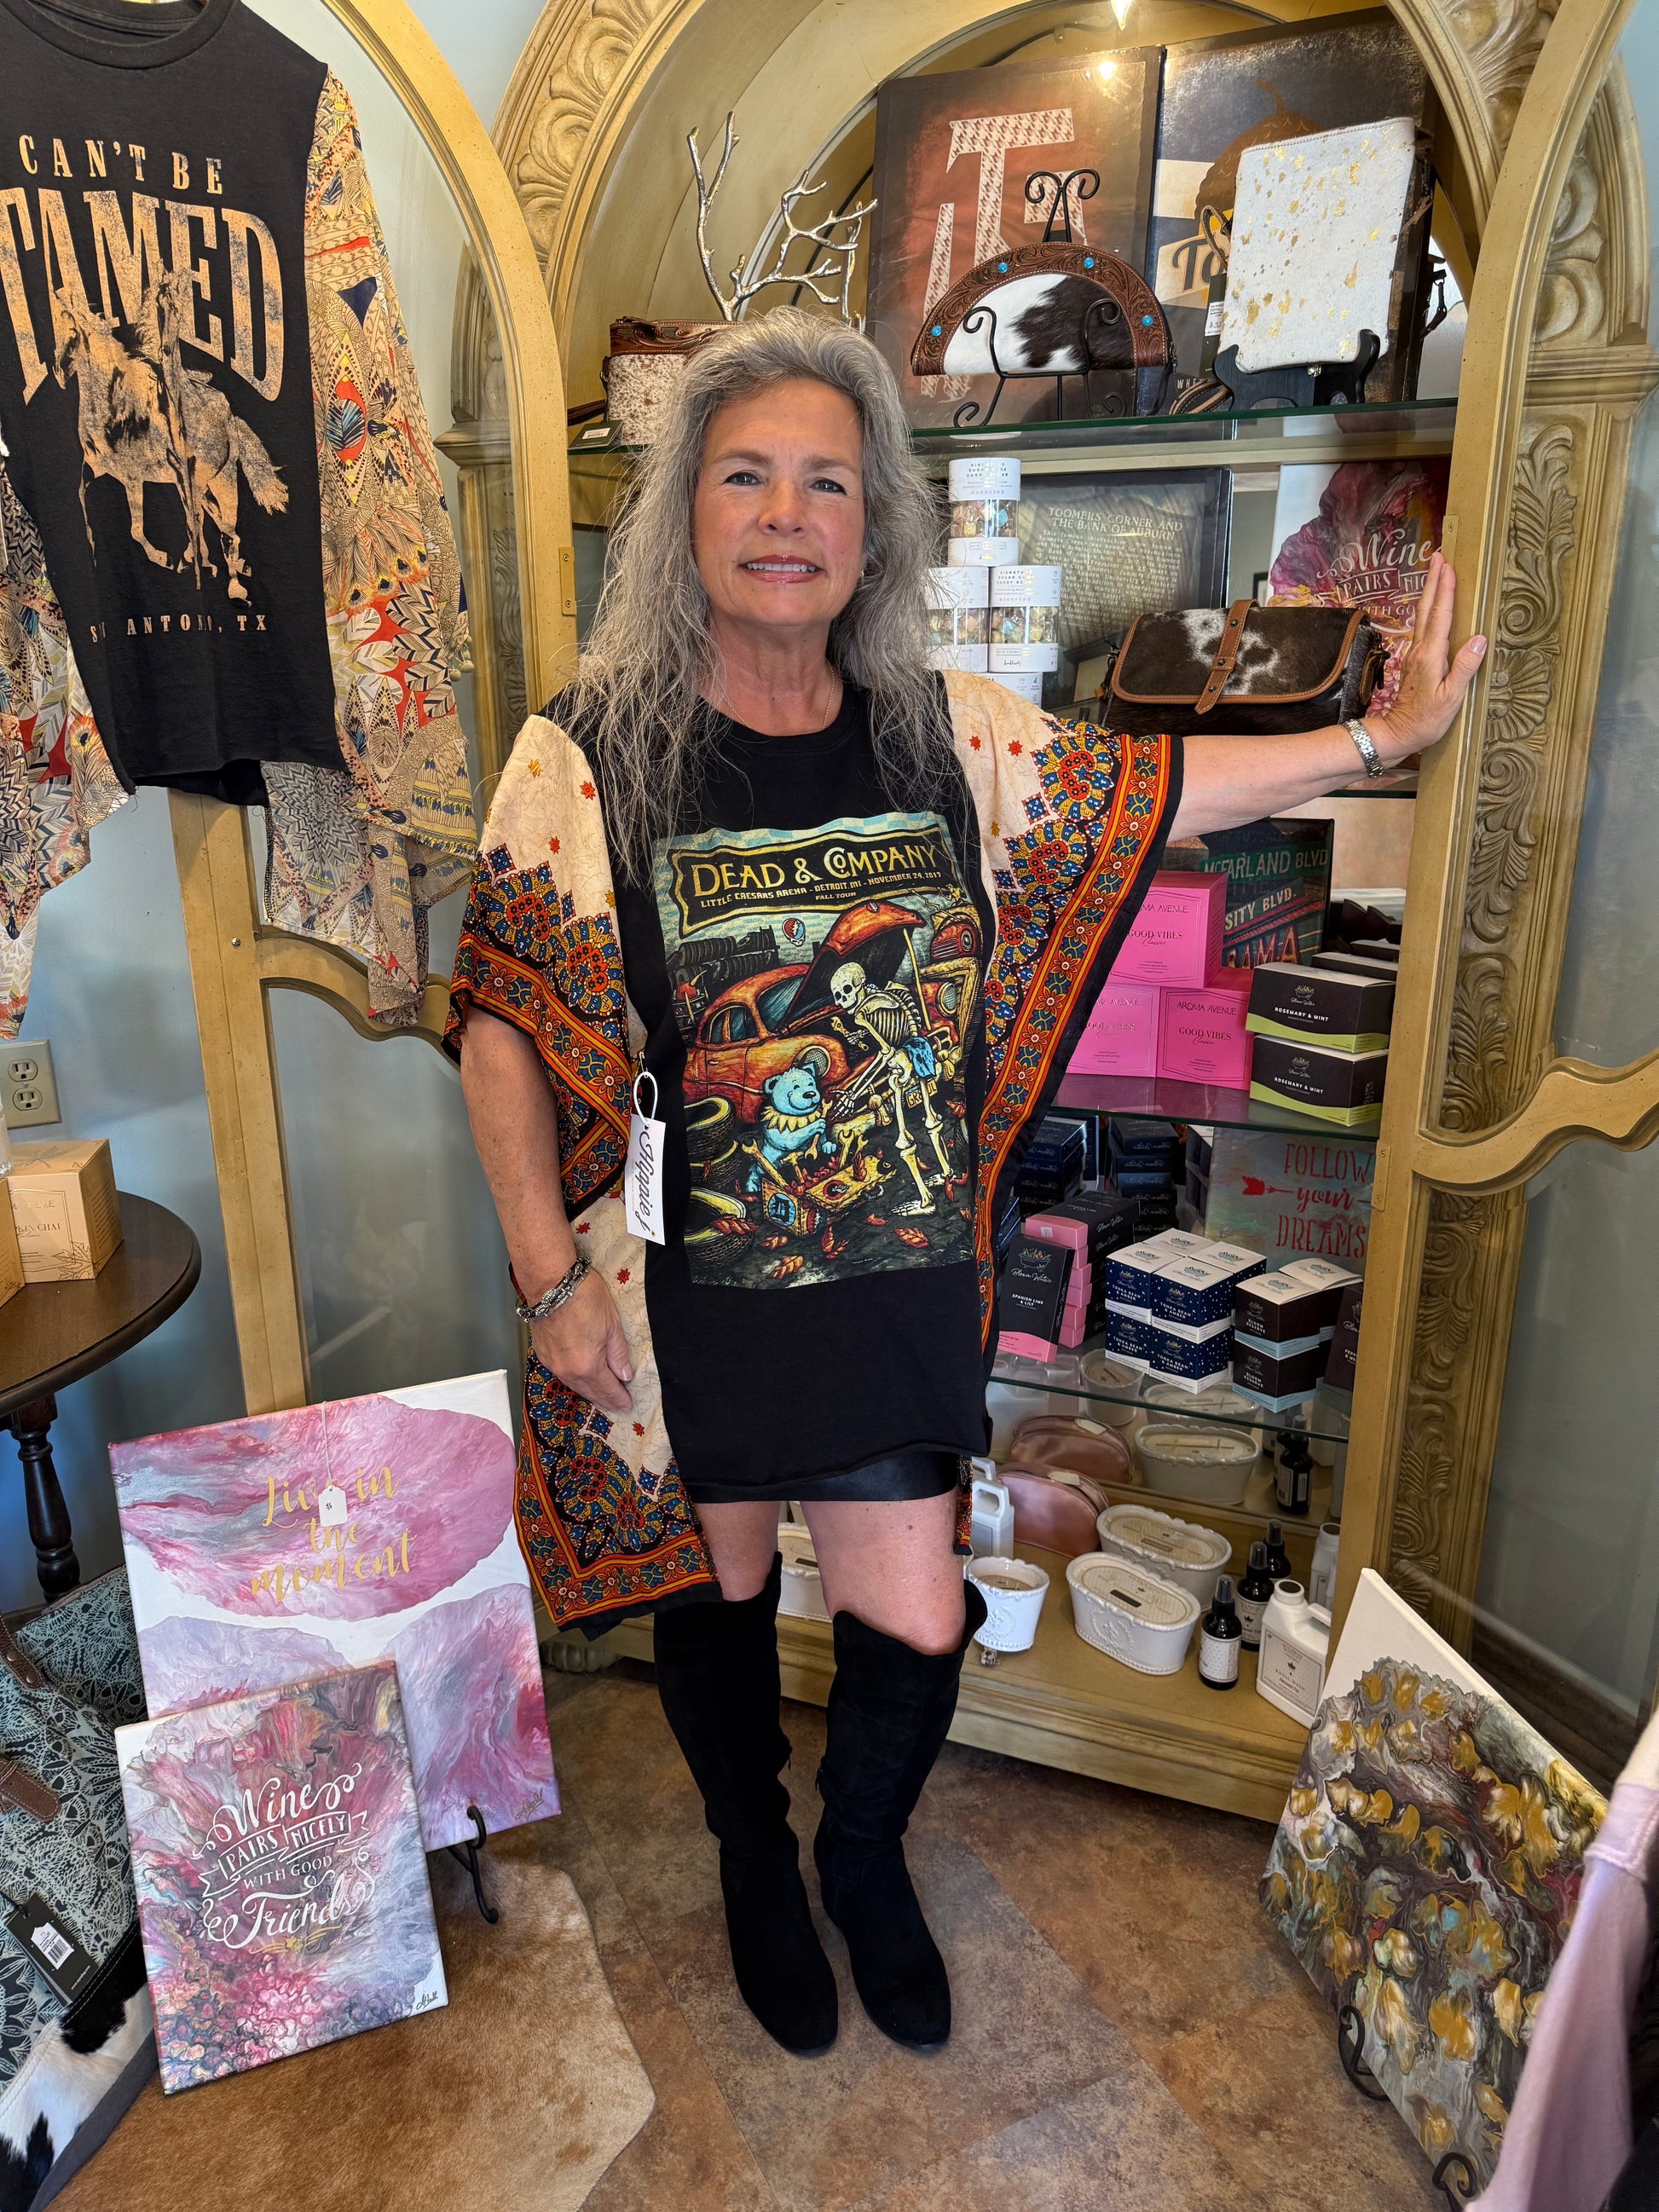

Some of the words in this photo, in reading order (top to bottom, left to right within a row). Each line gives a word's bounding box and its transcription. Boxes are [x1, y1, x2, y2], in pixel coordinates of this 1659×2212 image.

[18, 134, 146, 182] CAN'T
[171, 152, 223, 195] BE
[0, 187, 285, 406] TAMED
[1049, 506, 1101, 523] TOOMERS
[1107, 513, 1153, 528] CORNER
[1157, 520, 1183, 532] AND
[1051, 517, 1074, 529] THE
[1077, 521, 1107, 533] BANK
[1111, 524, 1127, 534] OF
[1129, 526, 1176, 541] AUBURN
[1323, 528, 1442, 578] Wine
[1344, 571, 1391, 599] PAIRS
[236, 615, 267, 632] TX
[1295, 849, 1329, 869] BLVD
[691, 863, 785, 898] DEAD
[793, 858, 824, 884] &
[823, 845, 938, 879] COMPANY
[700, 893, 733, 908] LITTLE
[734, 892, 775, 900] CAESARS
[775, 887, 807, 898] ARENA
[867, 873, 912, 886] NOVEMBER
[1262, 887, 1297, 913] BLVD.
[1157, 905, 1188, 914] AVENUE
[1128, 929, 1154, 939] GOOD
[1156, 931, 1184, 940] VIBES
[1176, 1002, 1205, 1012] AROMA
[1207, 1005, 1237, 1015] AVENUE
[1274, 1007, 1307, 1018] ROSEMARY
[1110, 1023, 1136, 1031] VIBES
[1178, 1027, 1204, 1037] GOOD
[1205, 1031, 1233, 1040] VIBES
[1274, 1077, 1304, 1089] ROSEMARY
[1309, 1085, 1324, 1094] MINT
[1283, 1143, 1374, 1183] FOLLOW
[634, 1130, 655, 1218] Hippie
[1297, 1186, 1355, 1213] your
[38, 1222, 61, 1232] CHAI
[1275, 1215, 1367, 1259] DREAMS
[1010, 1268, 1032, 1278] Bloom
[1032, 1272, 1053, 1284] Water
[1012, 1293, 1032, 1302] SPANISH
[1112, 1284, 1128, 1295] TONKA
[1128, 1290, 1142, 1299] BEAN
[1120, 1292, 1136, 1302] AMBER
[1159, 1302, 1176, 1313] TONKA
[1177, 1308, 1192, 1317] BEAN
[1169, 1309, 1187, 1320] AMBER
[1246, 1322, 1266, 1335] RESERVE
[1247, 1318, 1264, 1329] BLOOM
[1113, 1336, 1129, 1346] TONKA
[1129, 1342, 1142, 1351] BEAN
[1121, 1343, 1138, 1354] AMBER
[1157, 1354, 1174, 1365] TONKA
[1174, 1360, 1188, 1370] BEAN
[1165, 1362, 1183, 1372] AMBER
[1243, 1375, 1264, 1389] RESERVE
[1246, 1372, 1262, 1383] BLOOM
[356, 1466, 400, 1500] in
[303, 1517, 367, 1554] the
[251, 1532, 418, 1603] moment
[196, 1770, 348, 1851] Wine
[226, 1829, 279, 1873] PAIRS
[290, 1814, 346, 1850] NICELY
[243, 1868, 286, 1890] WITH
[291, 1855, 333, 1876] GOOD
[223, 1872, 373, 1949] Friends
